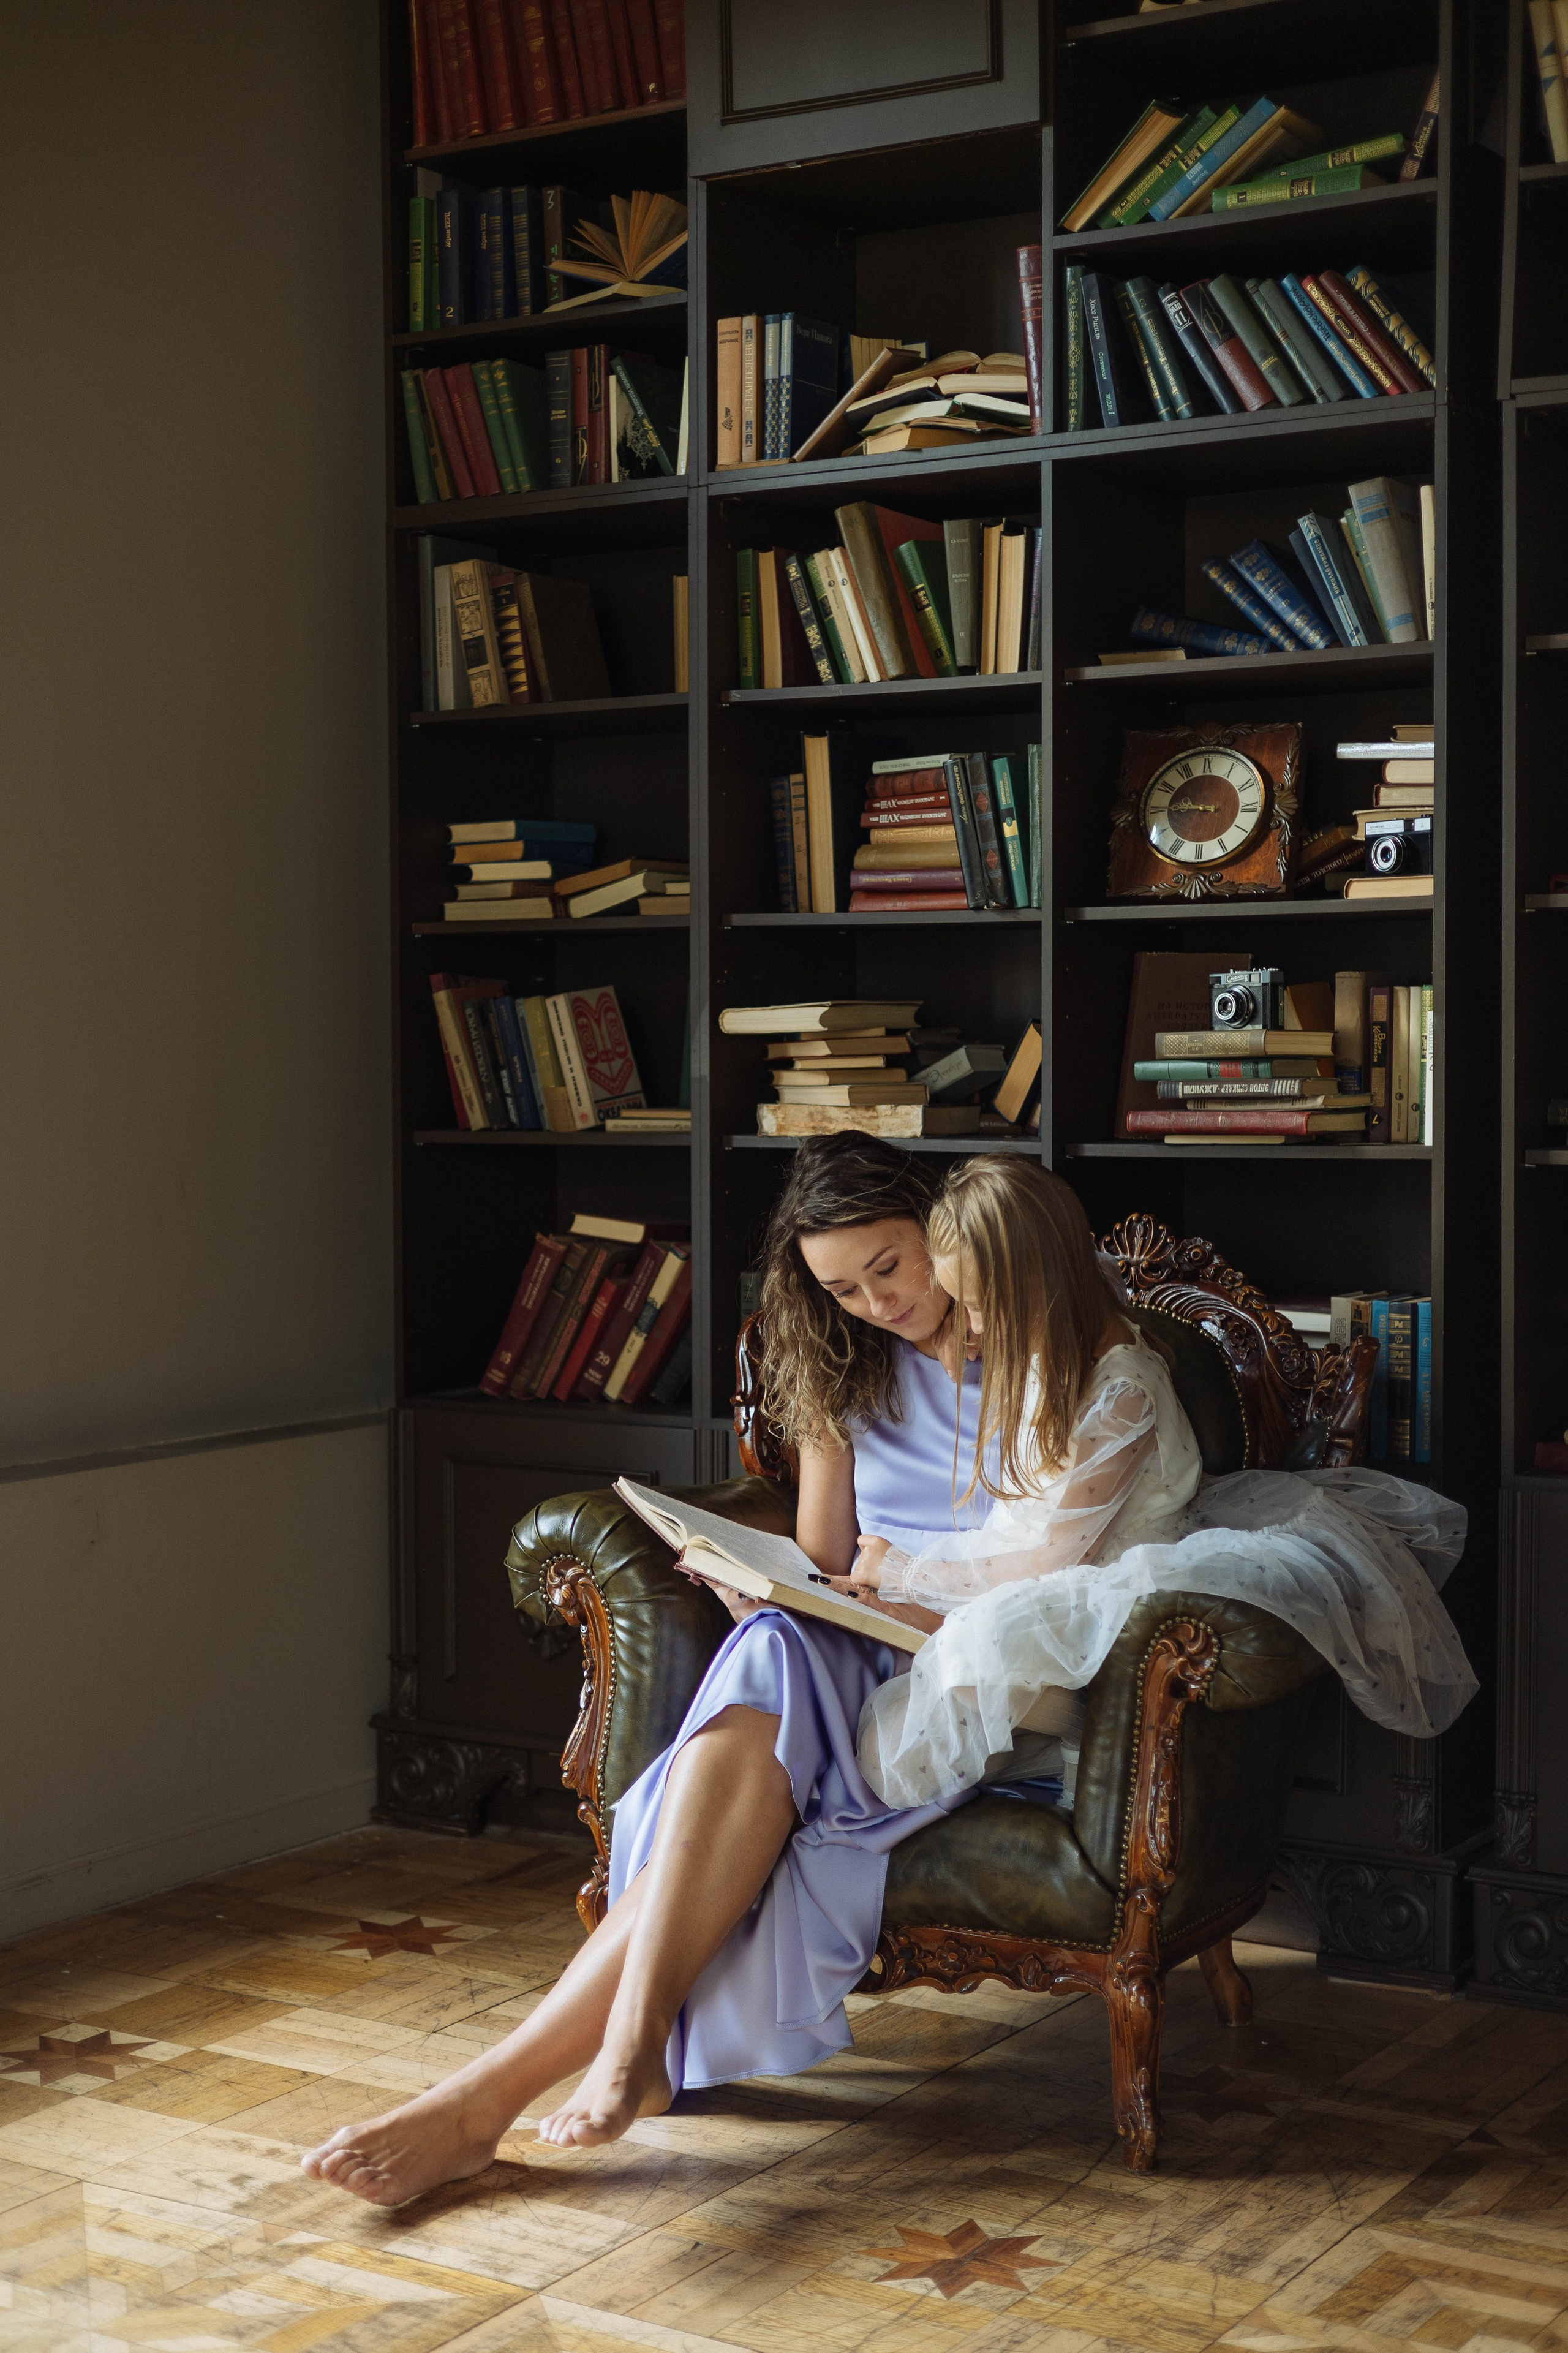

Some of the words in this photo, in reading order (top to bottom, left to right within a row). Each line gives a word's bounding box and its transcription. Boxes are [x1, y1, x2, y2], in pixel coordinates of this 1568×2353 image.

[1413, 127, 1427, 148] Вадим
[1414, 119, 1434, 157] Кожевников
[1088, 297, 1099, 315] Хосе
[1338, 293, 1352, 312] поэмы
[445, 307, 453, 317] 2
[1174, 312, 1186, 326] 11
[1090, 315, 1103, 340] Рисаль
[1353, 314, 1368, 332] Стихи
[1147, 317, 1167, 364] Татьяничева
[1095, 351, 1110, 380] Сочинения
[1145, 366, 1161, 400] Людмила
[1164, 363, 1179, 396] Людмила
[1102, 392, 1115, 411] том
[1314, 539, 1327, 568] ГРИБАЧЕВ
[1325, 568, 1340, 595] НИКОЛАЙ
[1176, 763, 1194, 780] VIII
[1203, 758, 1213, 773] IX
[1224, 763, 1237, 778] X
[953, 765, 966, 806] ФЕЙХТВАНГЕР
[1158, 781, 1175, 795] VII
[1237, 778, 1255, 793] XI
[880, 798, 897, 809] XVIII
[1240, 801, 1258, 813] XII
[878, 813, 900, 823] XVIII
[958, 805, 969, 825] Лион
[1234, 825, 1248, 833] I
[1168, 837, 1185, 855] IIII
[1194, 844, 1203, 859] III
[1218, 838, 1227, 852] II
[551, 1001, 565, 1037] ОКЕАНИИ
[561, 1039, 573, 1065] МИФЫ
[1373, 1025, 1381, 1063] Кожевников
[1377, 1033, 1386, 1054] Вадим
[570, 1076, 584, 1107] СКАЗКИ
[1183, 1083, 1218, 1095] ДЖУНГЛИ
[1221, 1083, 1248, 1093] СИНКЛЕР
[1250, 1082, 1269, 1092] ЭПТОН
[595, 1351, 610, 1367] 29
